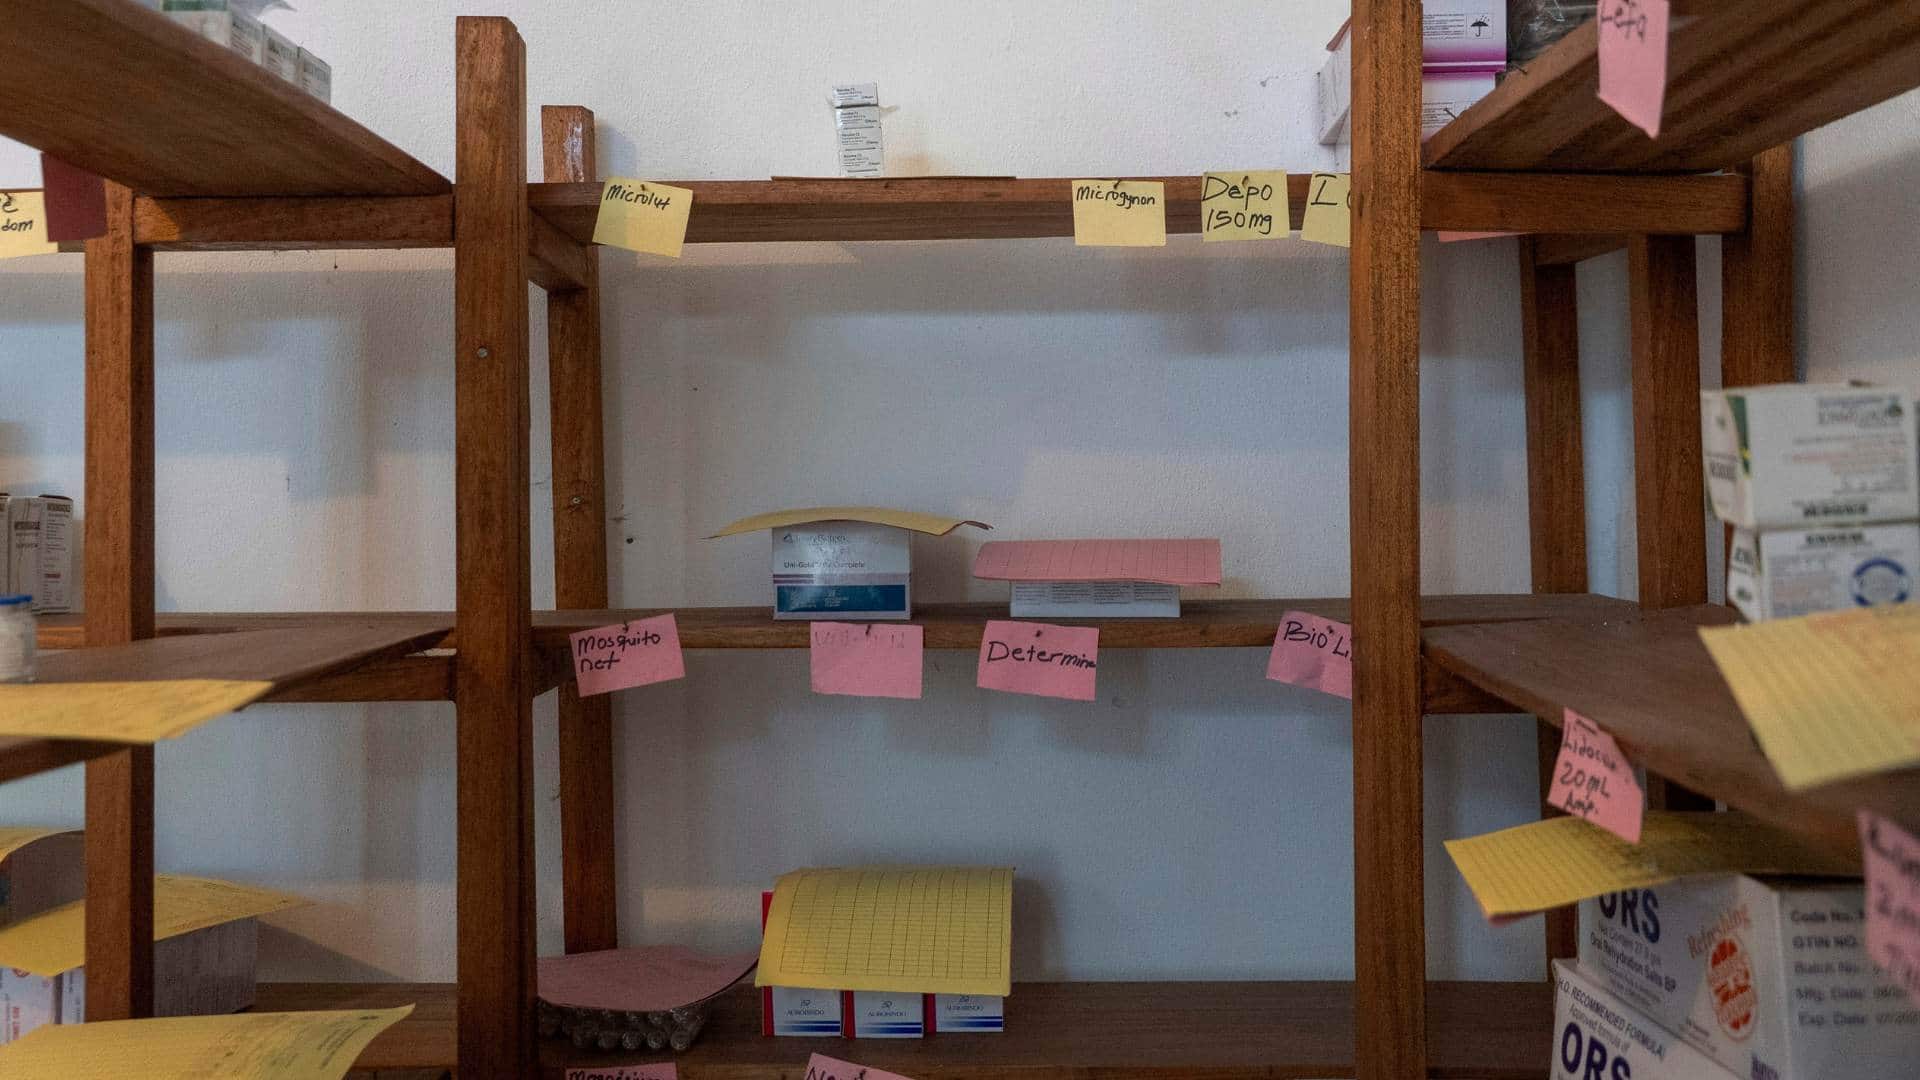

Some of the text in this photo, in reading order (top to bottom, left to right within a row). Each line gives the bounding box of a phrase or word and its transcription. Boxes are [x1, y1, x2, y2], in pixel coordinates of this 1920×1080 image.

[1076, 185, 1155, 210] Microgynon
[1201, 176, 1273, 211] Depo
[1599, 888, 1660, 943] ORS
[1571, 985, 1625, 1031] RECOMMENDED
[1561, 1021, 1632, 1080] ORS
